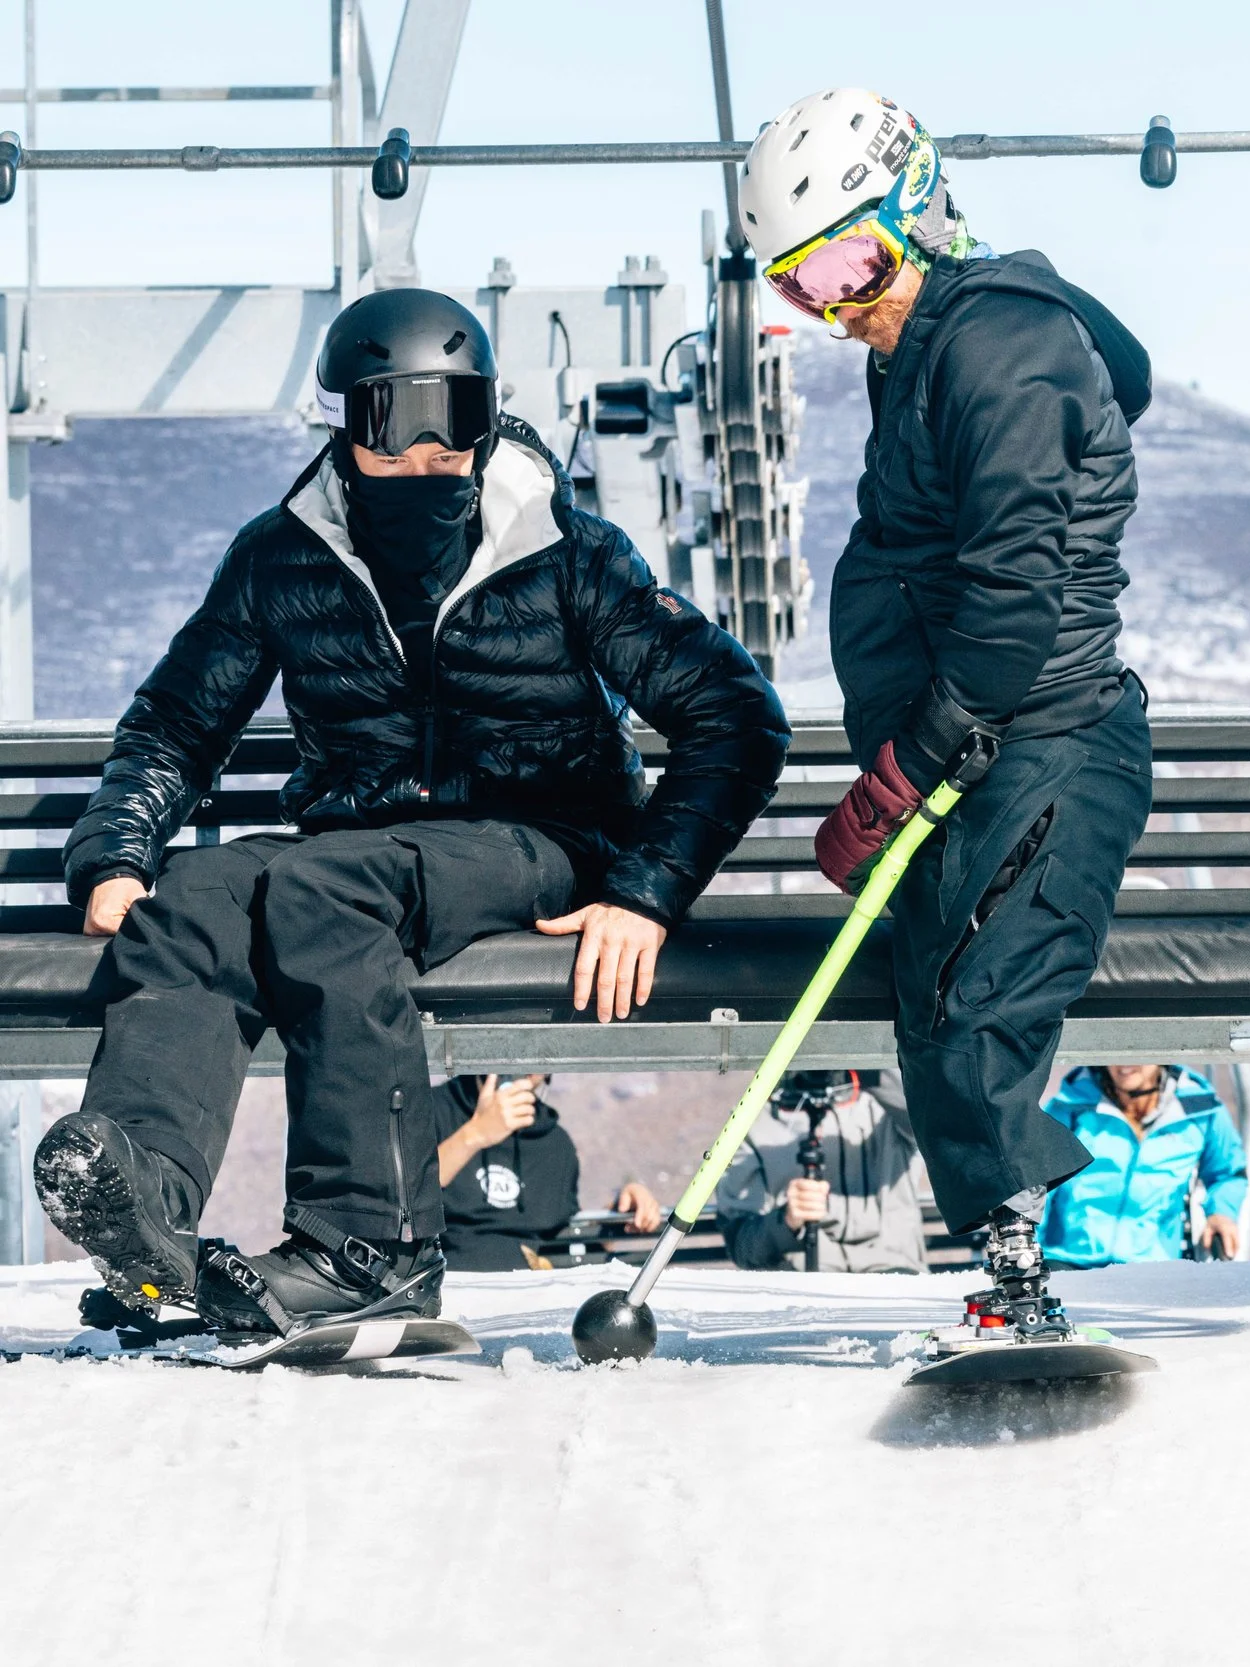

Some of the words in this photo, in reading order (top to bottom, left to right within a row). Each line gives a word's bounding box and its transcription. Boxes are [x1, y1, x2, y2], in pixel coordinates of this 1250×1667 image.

[865, 112, 897, 164] pret
[843, 178, 855, 190] YA
[851, 164, 866, 181] DIG?
